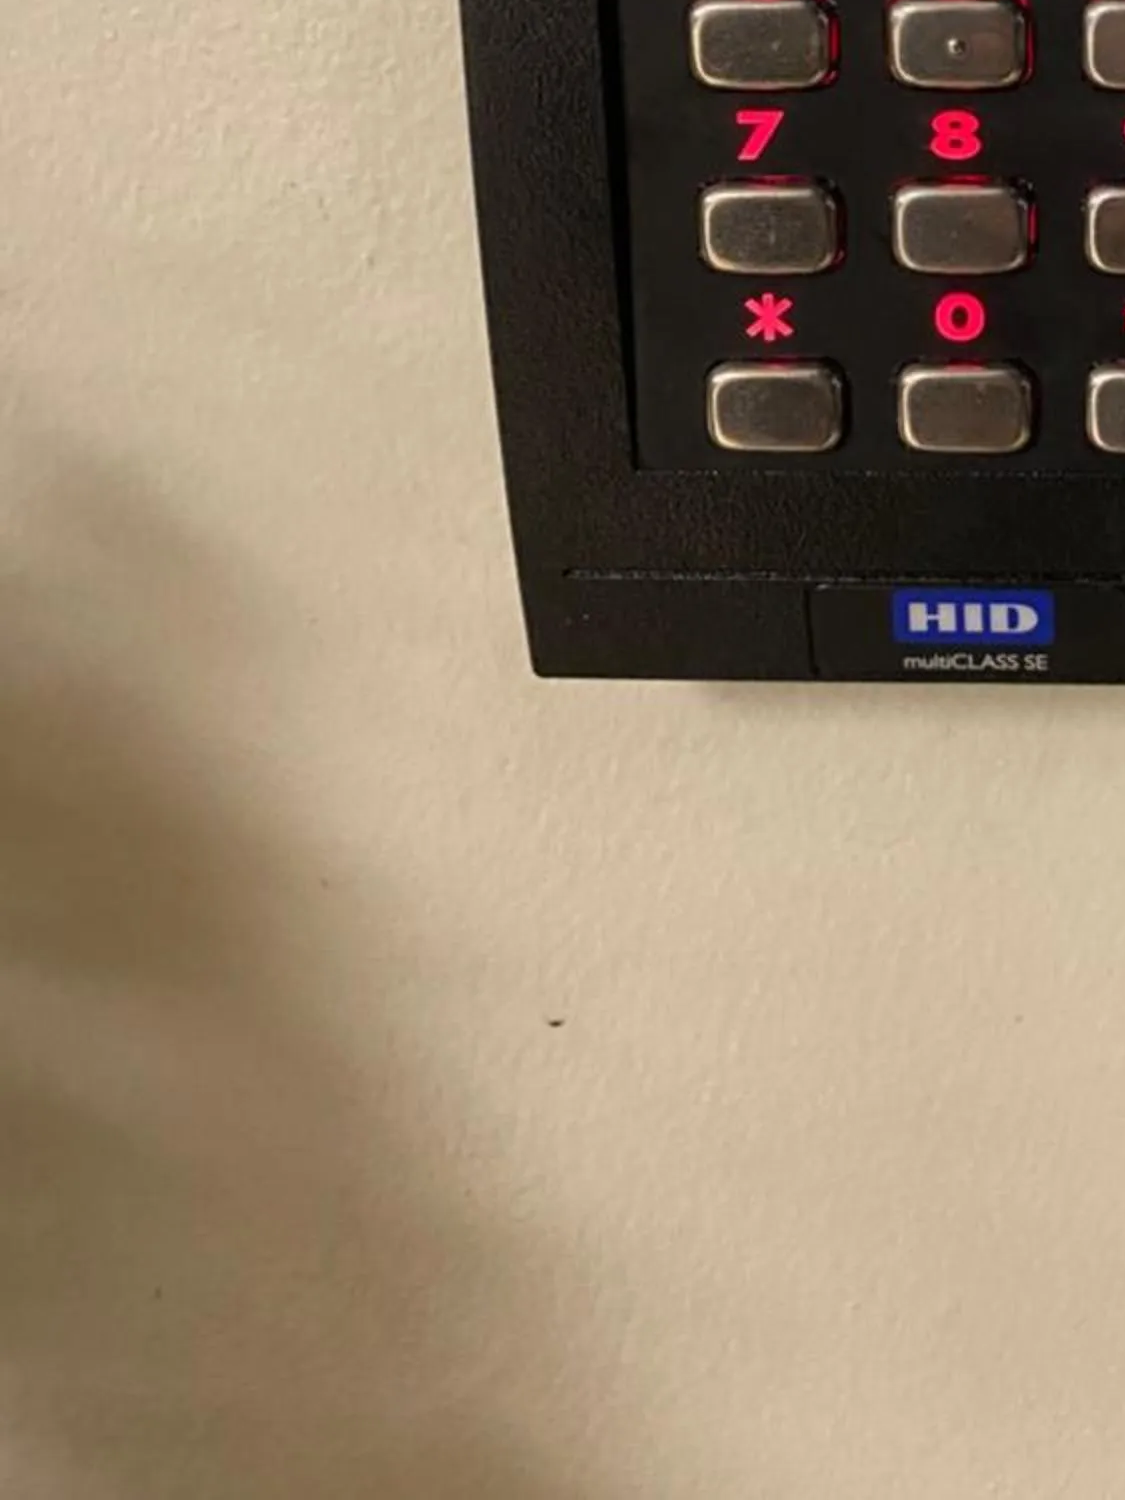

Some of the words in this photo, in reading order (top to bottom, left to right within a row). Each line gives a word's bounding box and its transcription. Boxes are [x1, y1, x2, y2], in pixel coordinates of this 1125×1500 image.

[735, 108, 785, 162] 7
[928, 109, 983, 161] 8
[933, 291, 986, 343] 0
[908, 602, 1039, 634] HID
[903, 652, 1019, 671] multiCLASS
[1024, 653, 1049, 671] SE
